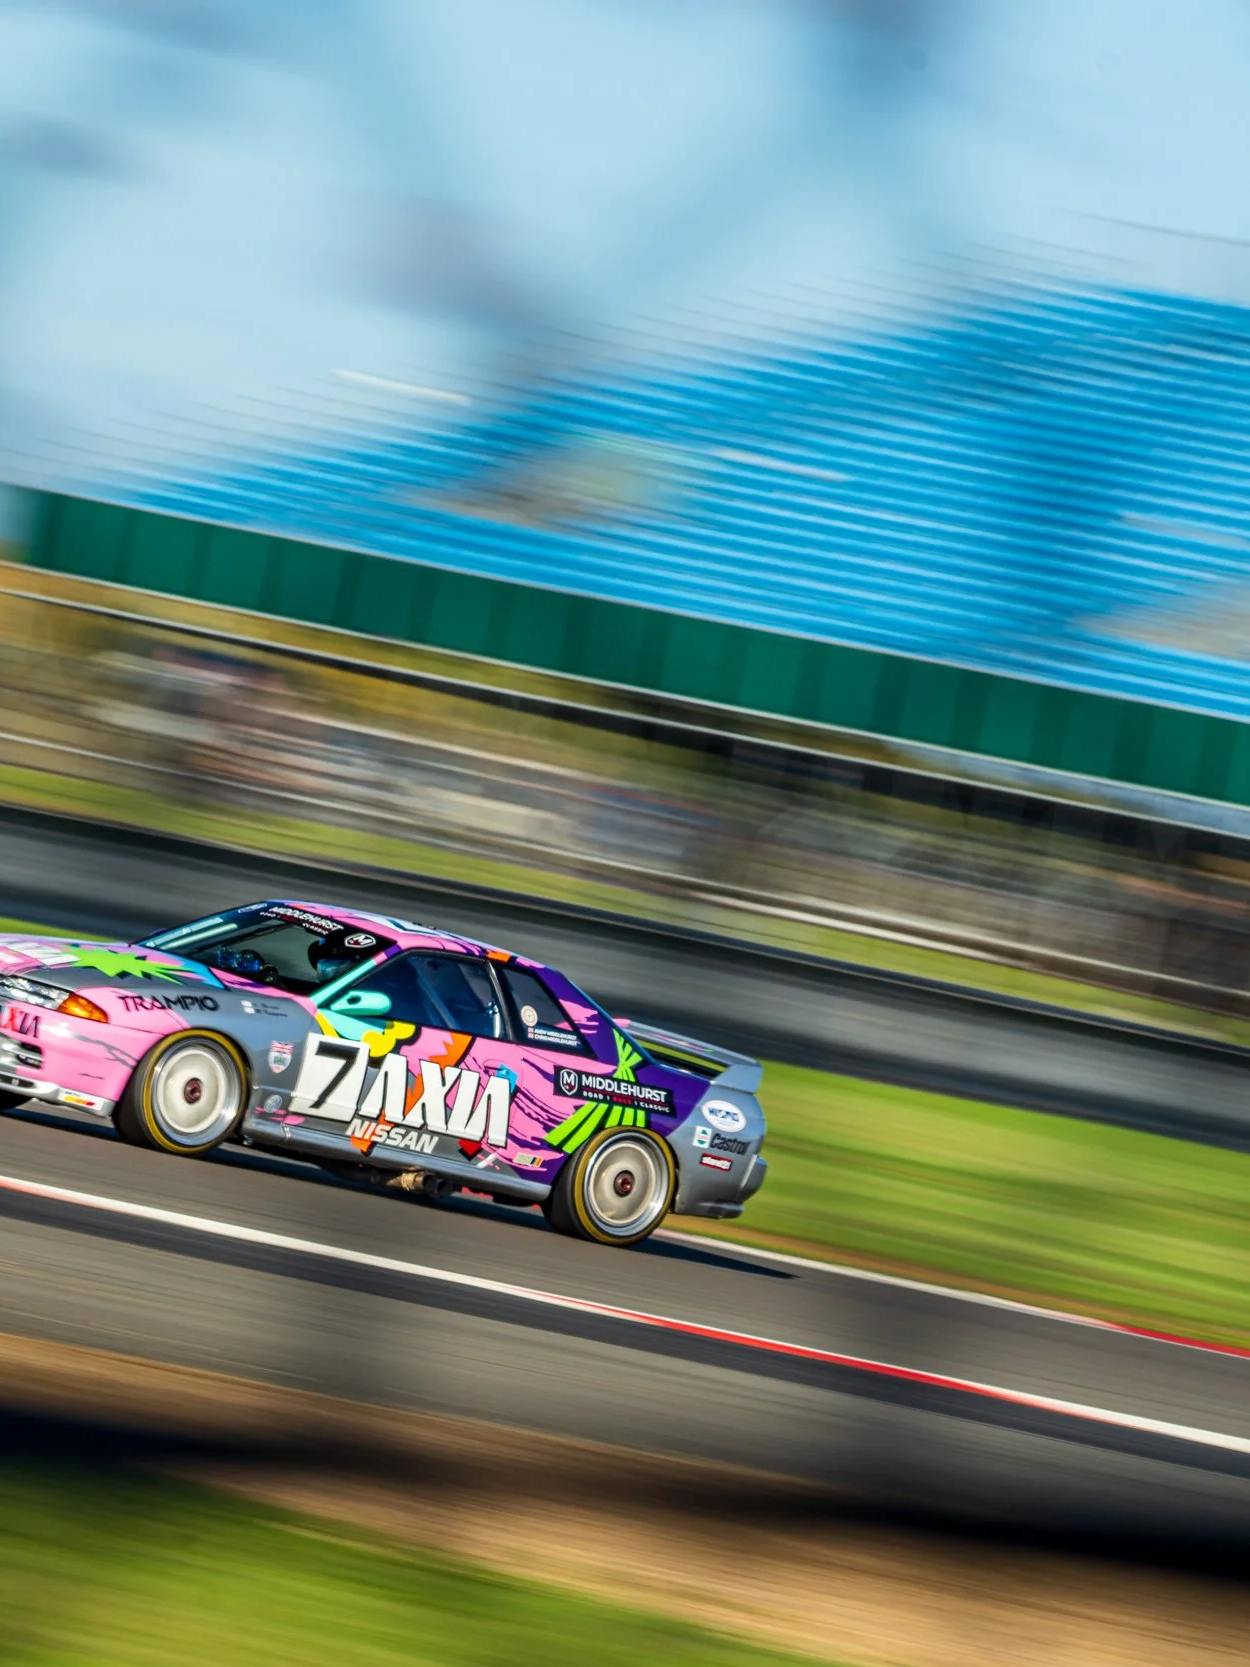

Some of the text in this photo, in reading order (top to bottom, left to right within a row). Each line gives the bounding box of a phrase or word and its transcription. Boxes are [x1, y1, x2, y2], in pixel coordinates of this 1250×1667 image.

[269, 907, 344, 931] MIDDLEHURST
[117, 995, 221, 1012] TRAMPIO
[309, 1041, 361, 1109] 7
[582, 1074, 667, 1102] MIDDLEHURST
[583, 1091, 670, 1113] ROAD RACE CLASSIC
[346, 1118, 439, 1154] NISSAN
[710, 1133, 751, 1155] Castrol
